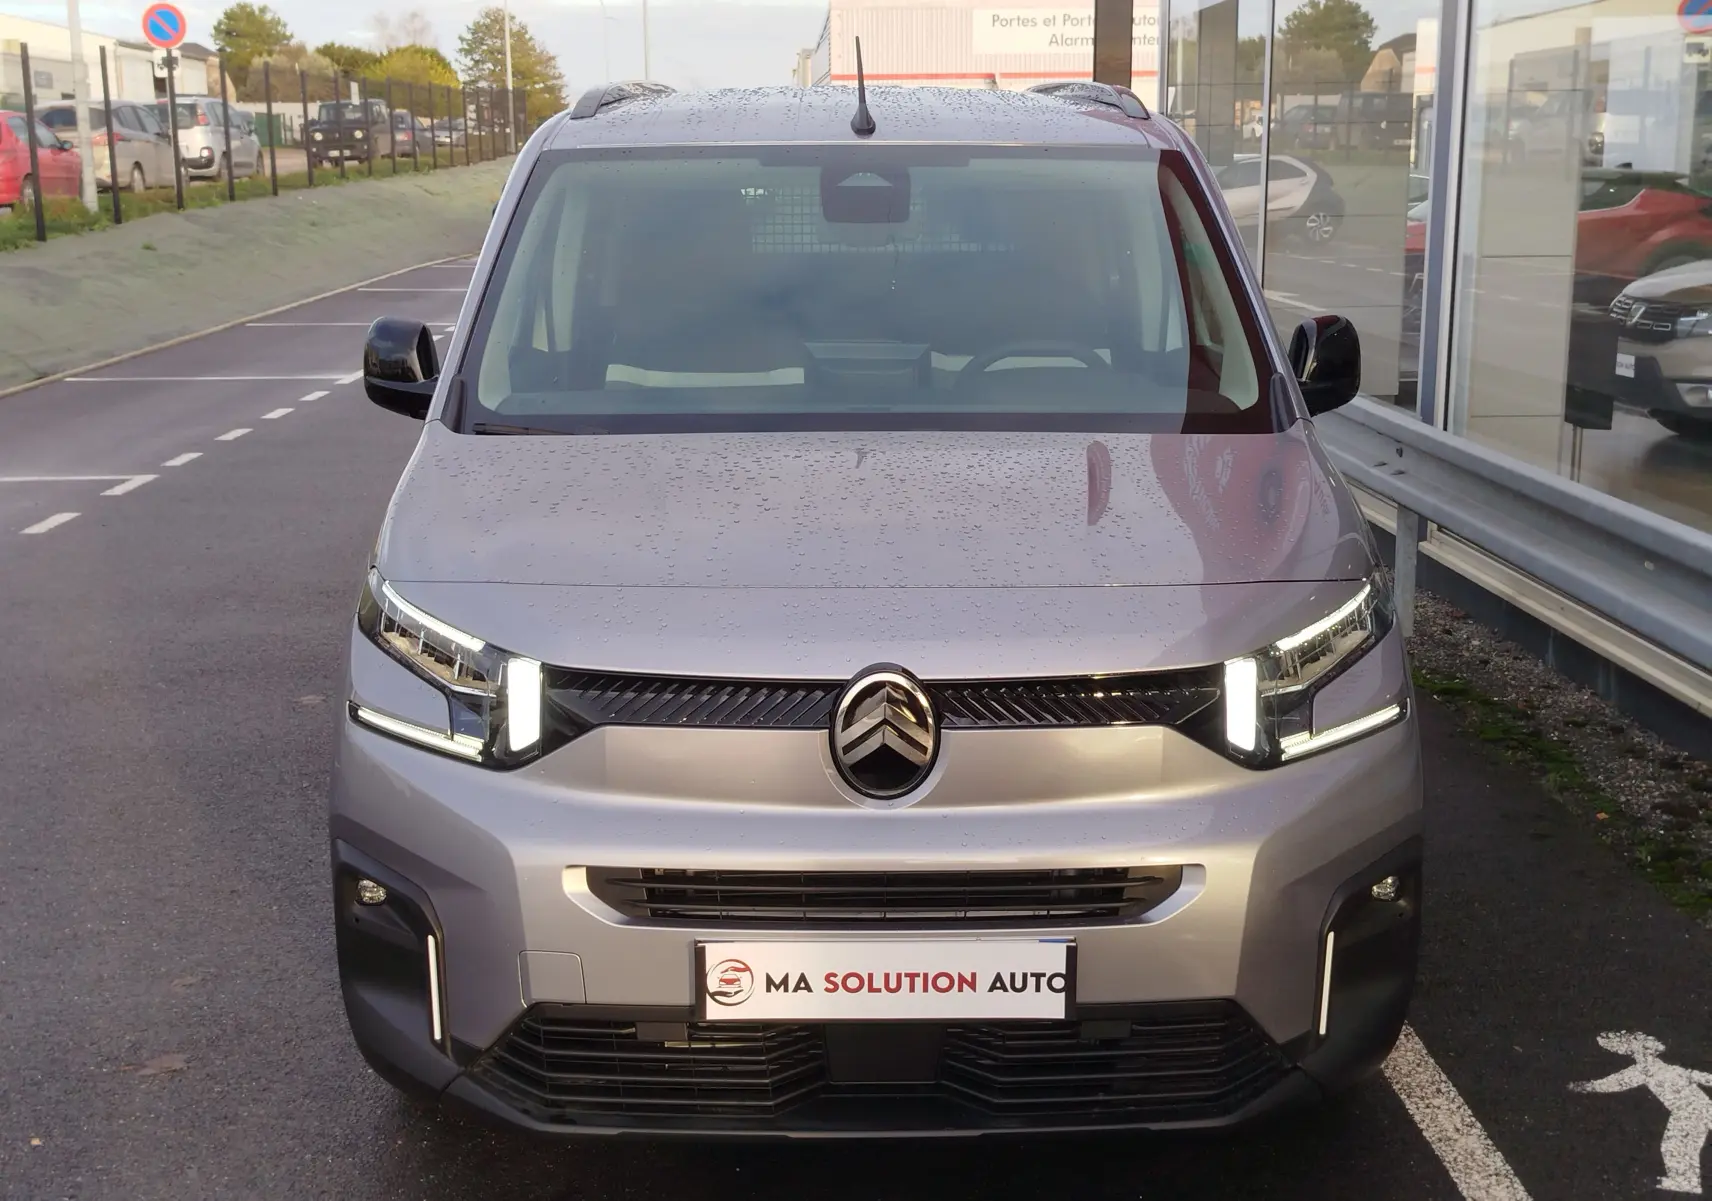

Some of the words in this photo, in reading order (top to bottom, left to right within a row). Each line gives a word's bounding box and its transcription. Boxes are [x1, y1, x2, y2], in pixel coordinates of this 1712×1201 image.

[992, 14, 1037, 27] Portes
[1043, 14, 1056, 27] et
[1063, 13, 1095, 27] Port
[1048, 33, 1095, 46] Alarm
[765, 972, 814, 993] MA
[824, 972, 977, 993] SOLUTION
[987, 972, 1067, 993] AUTO
